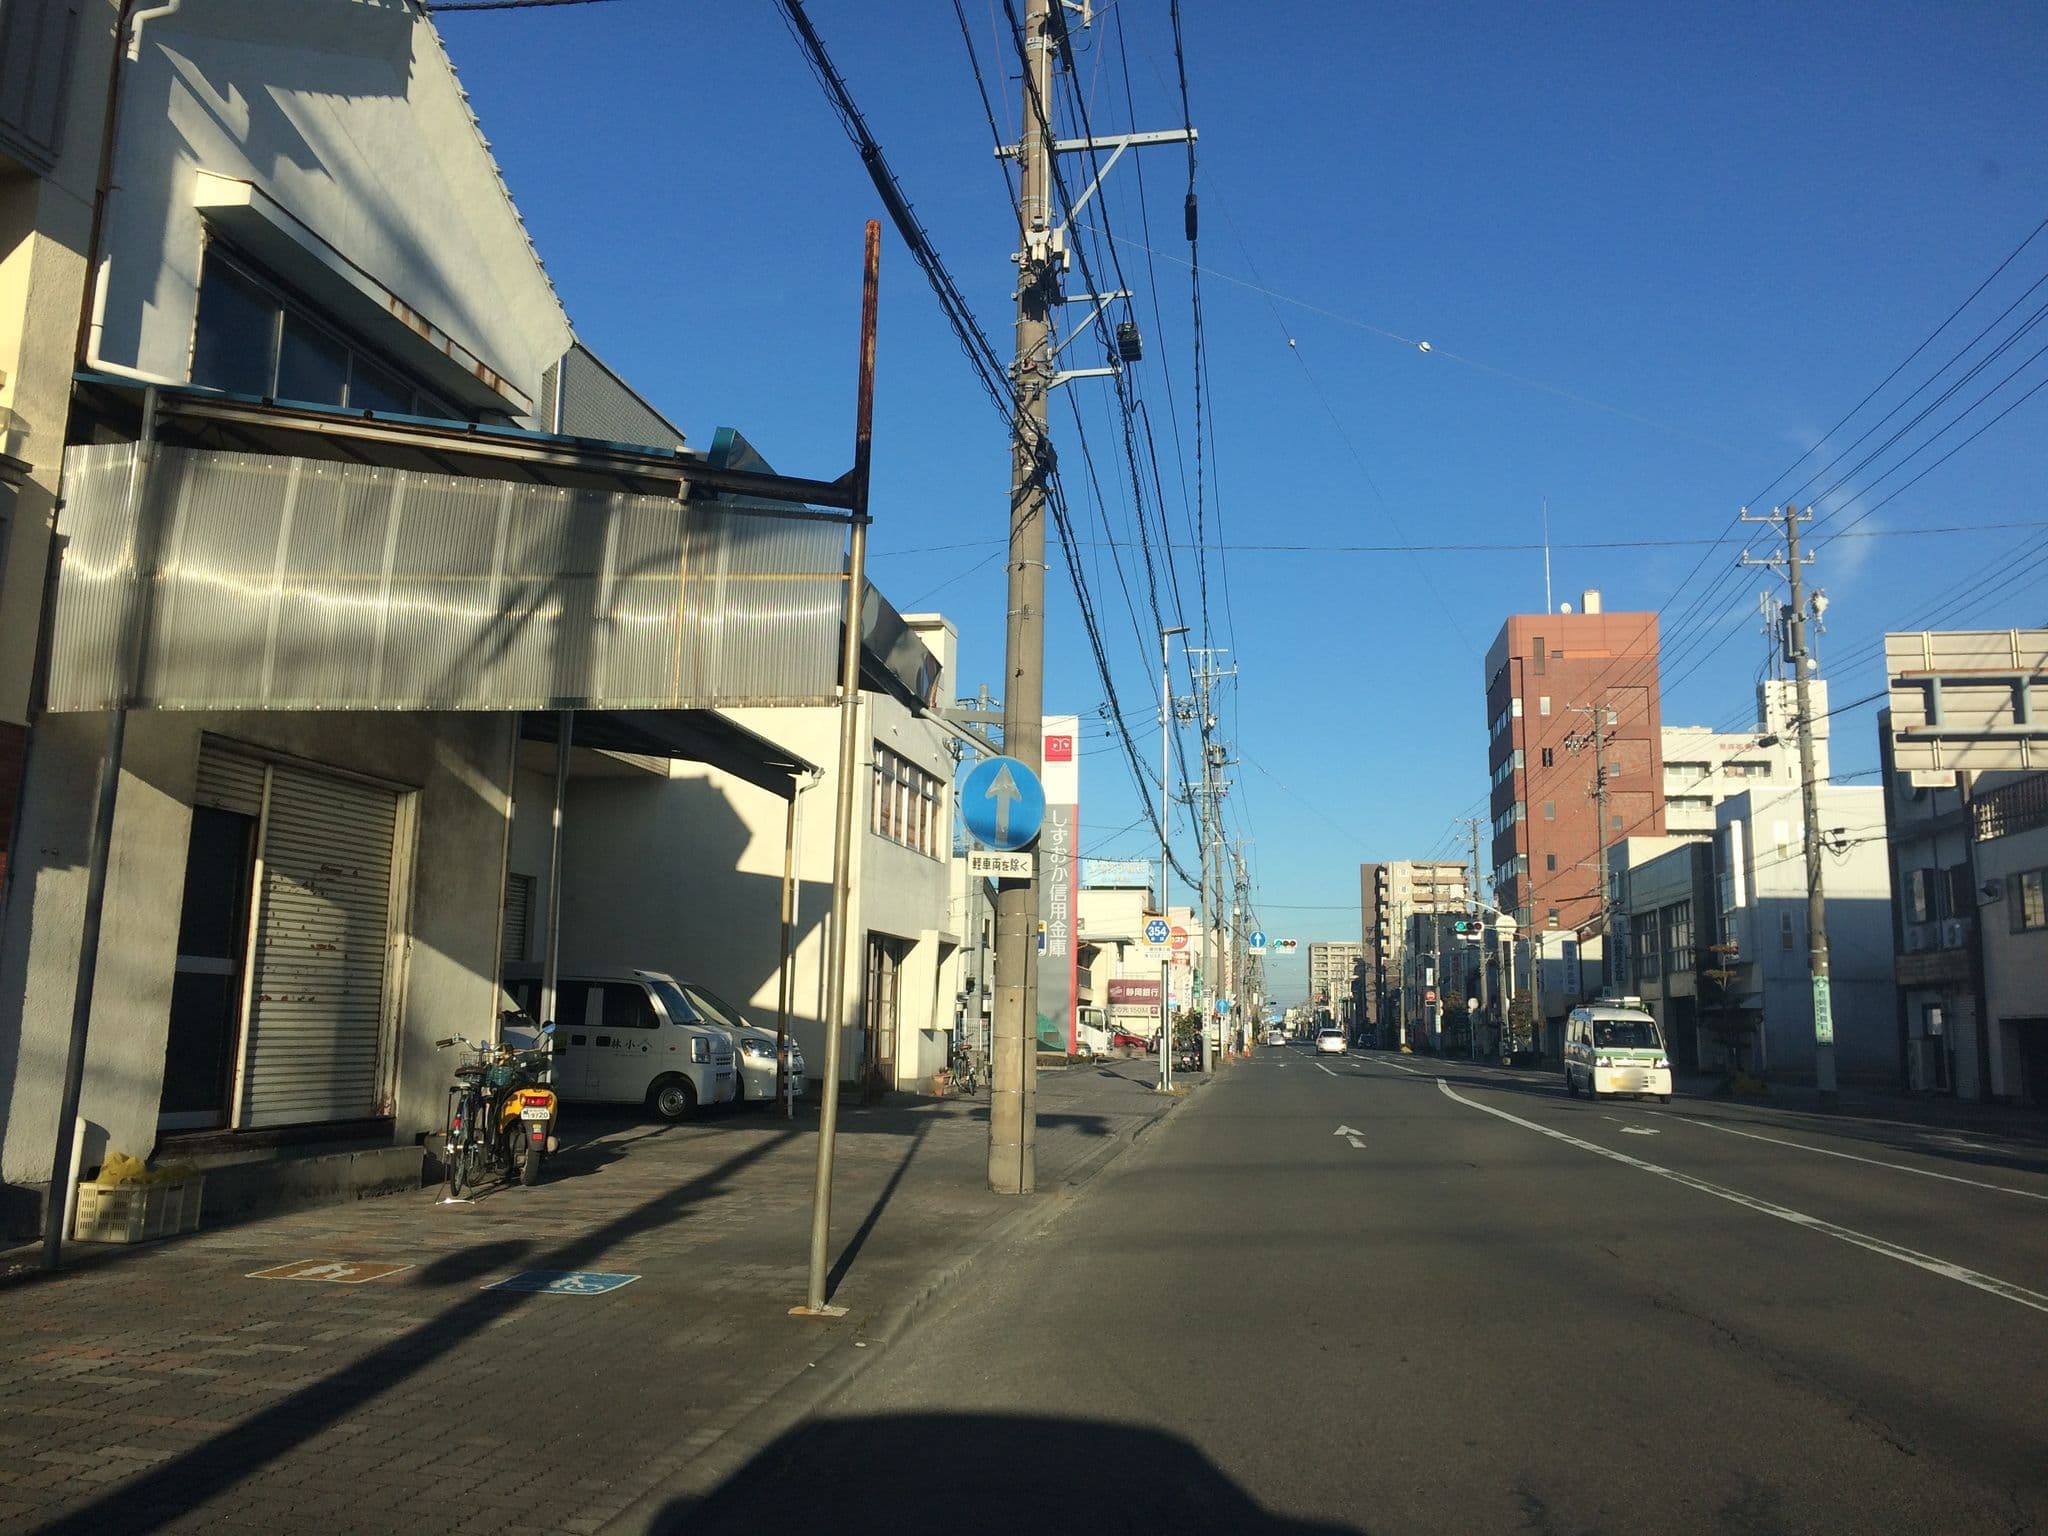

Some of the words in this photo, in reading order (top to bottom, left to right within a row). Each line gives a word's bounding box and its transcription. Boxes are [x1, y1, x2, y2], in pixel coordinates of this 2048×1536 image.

[971, 856, 1028, 872] 軽車両を除く
[1048, 809, 1068, 958] しずおか信用金庫
[1147, 926, 1167, 937] 354
[1125, 987, 1160, 997] 静岡銀行
